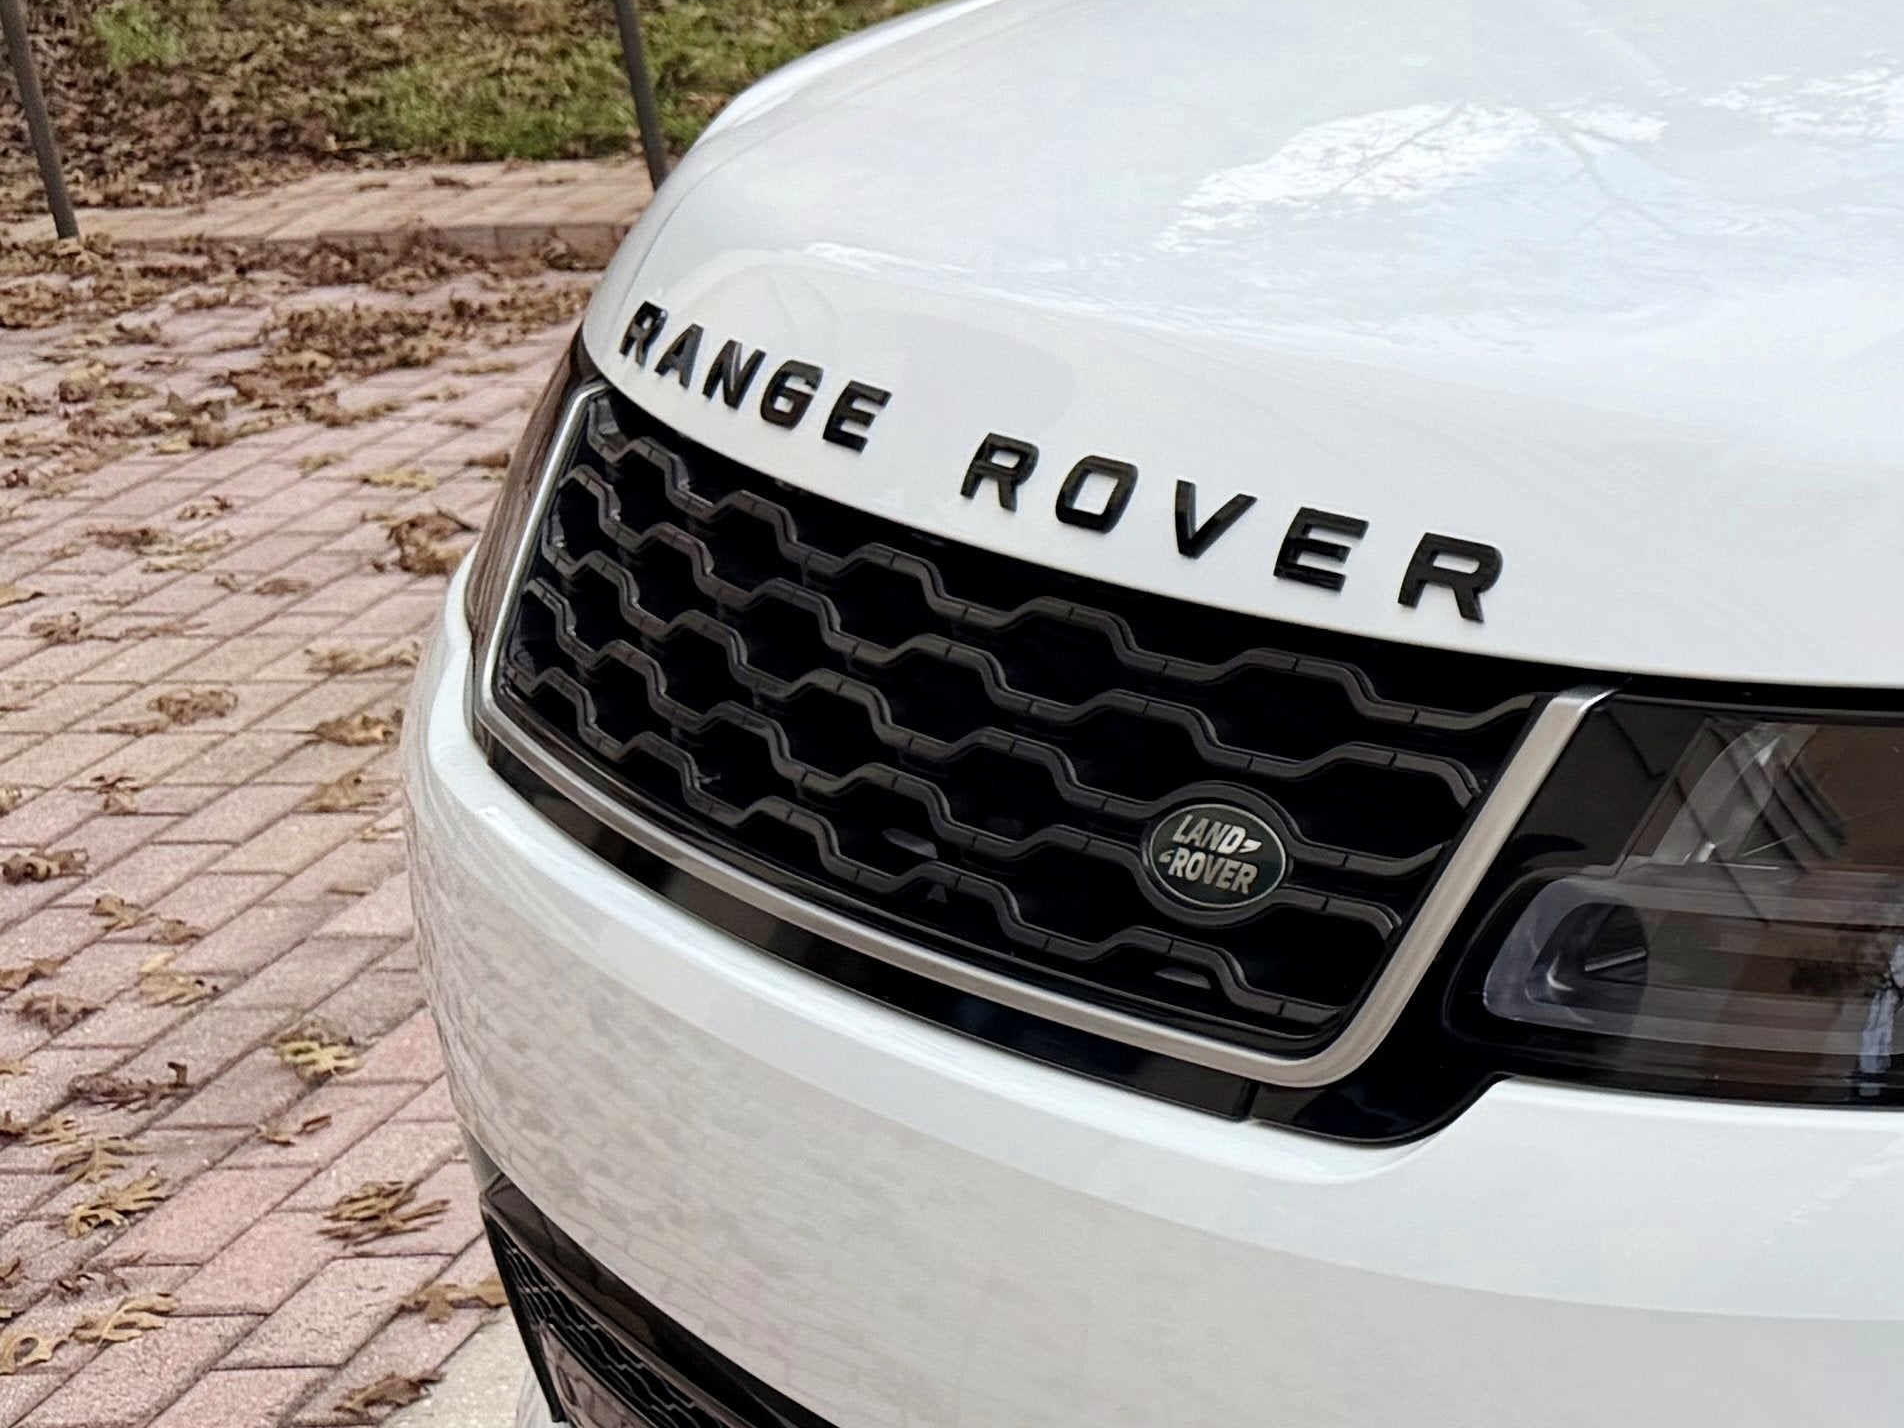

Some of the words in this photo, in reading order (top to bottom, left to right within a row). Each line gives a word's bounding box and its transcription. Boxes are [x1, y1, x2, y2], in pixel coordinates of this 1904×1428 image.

[619, 300, 892, 455] RANGE
[960, 432, 1504, 625] ROVER
[1171, 813, 1247, 855] LAND
[1167, 845, 1259, 896] ROVER
